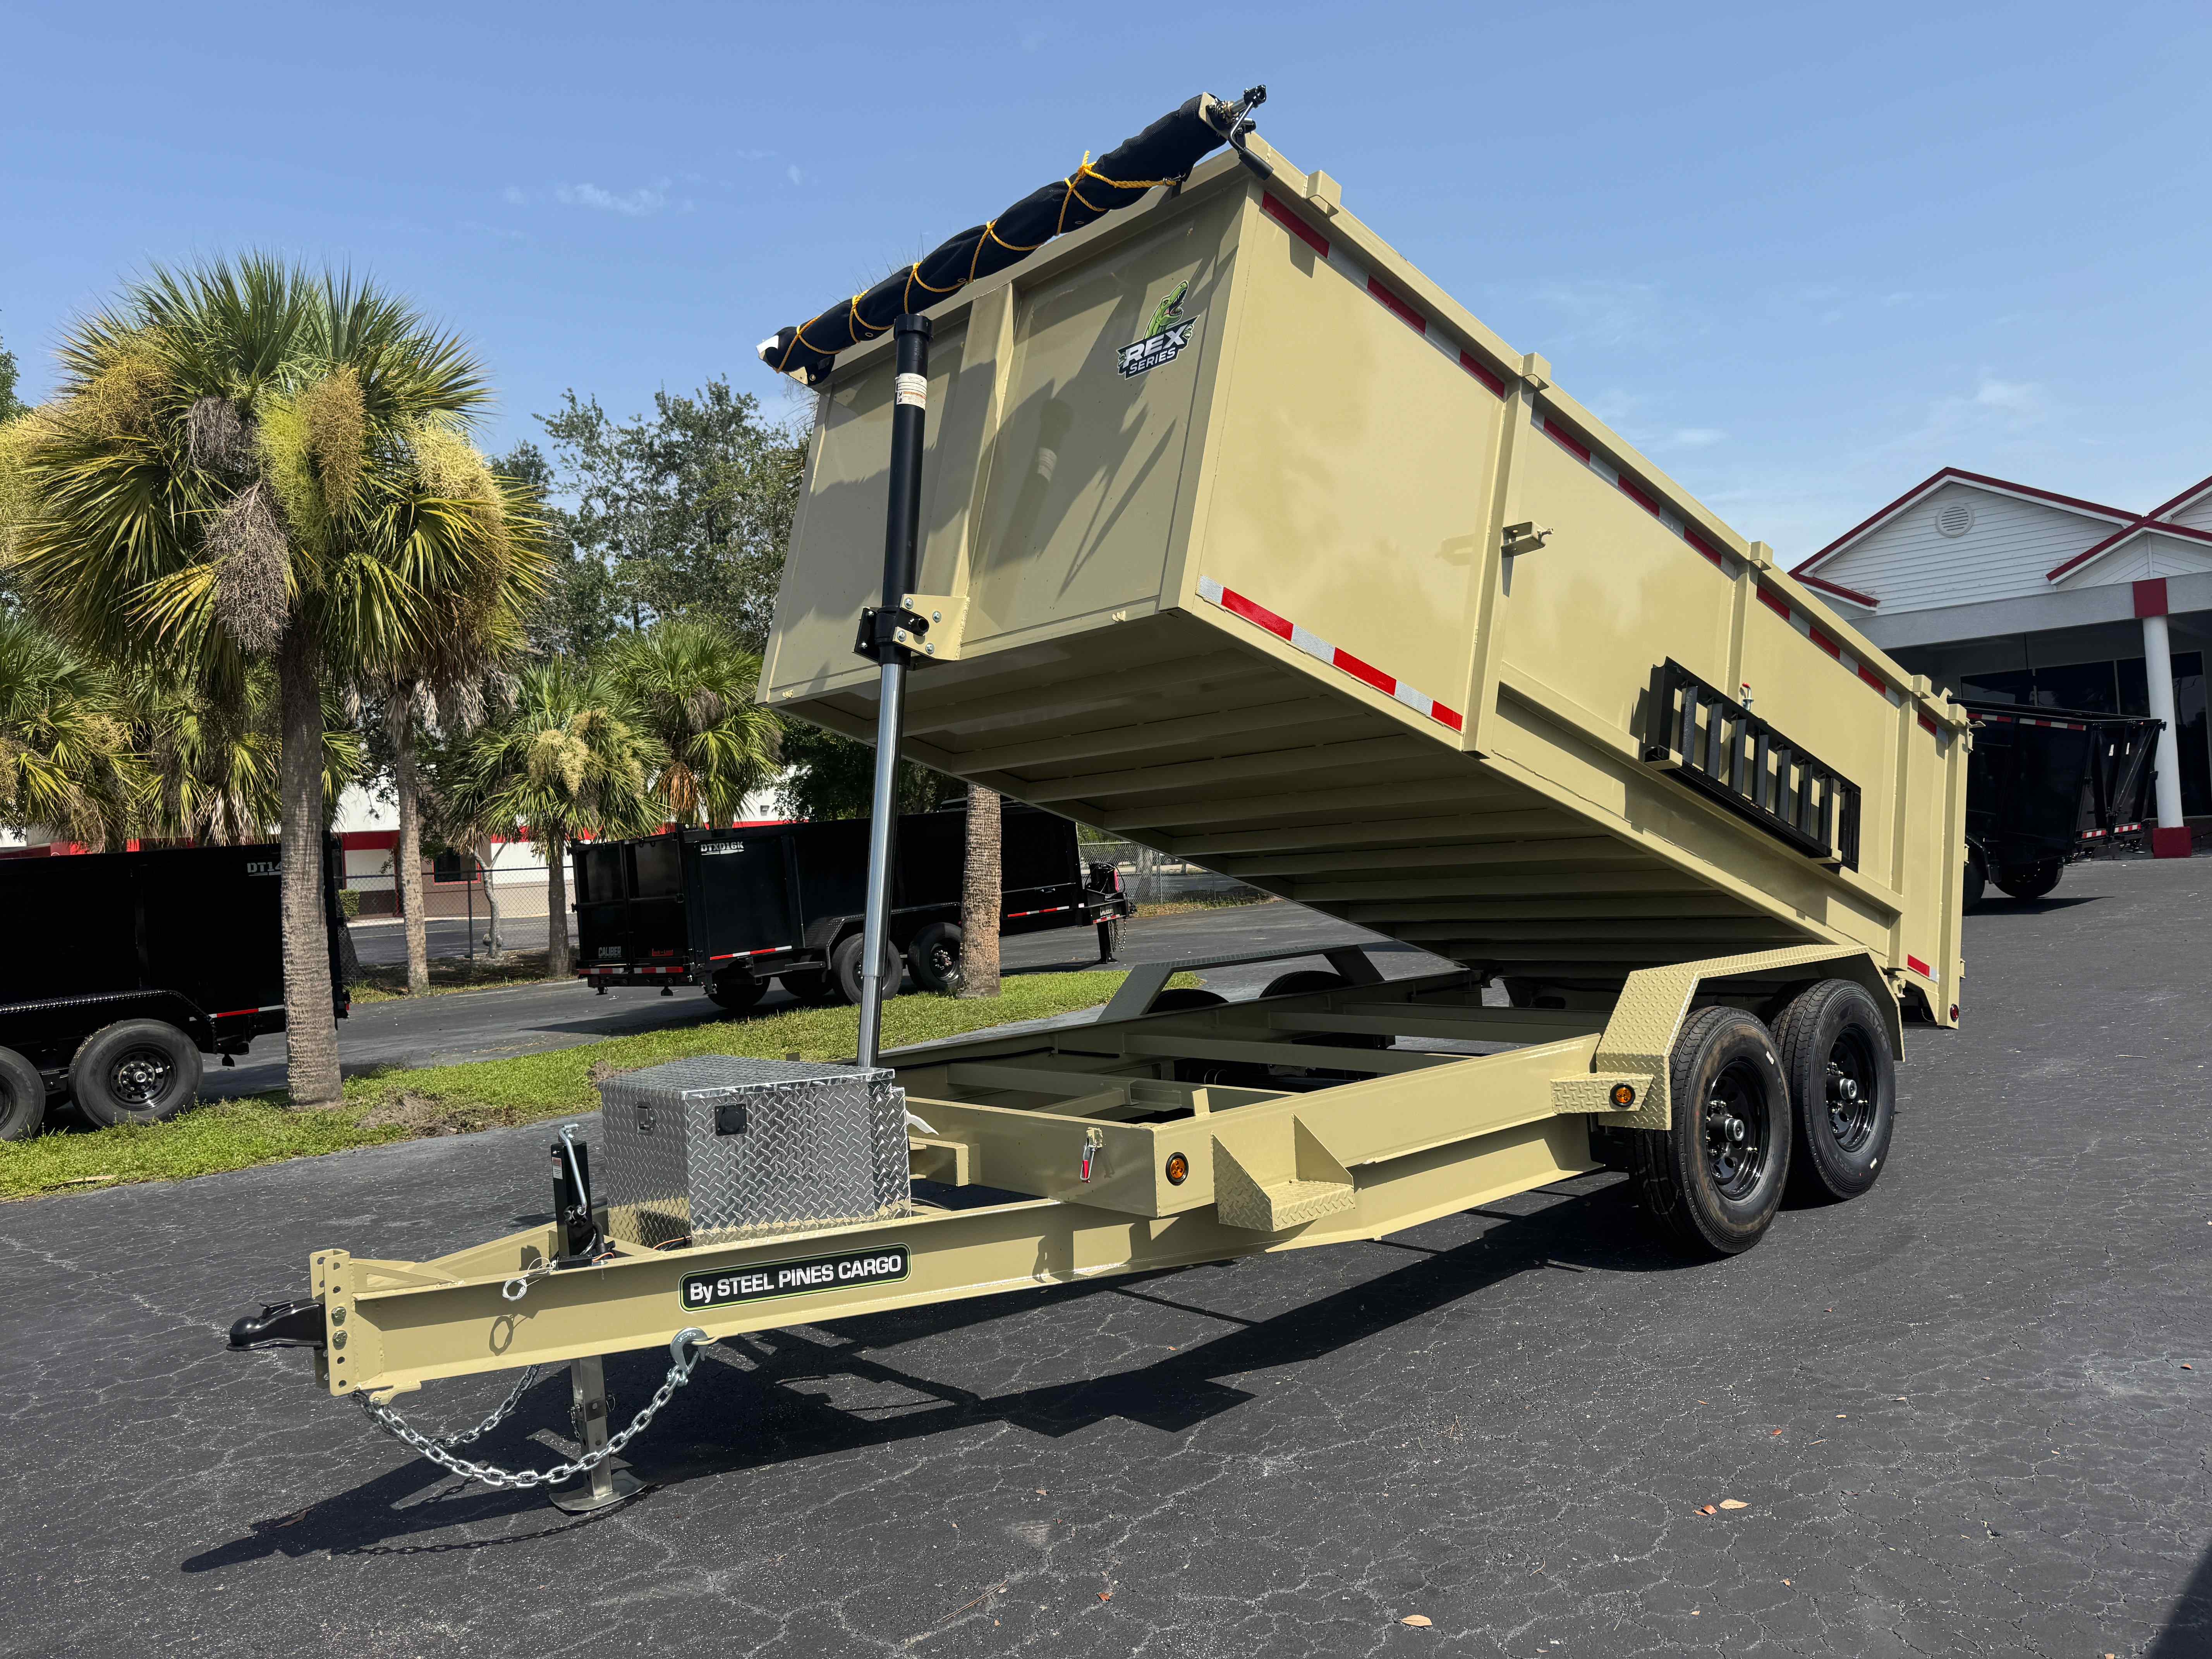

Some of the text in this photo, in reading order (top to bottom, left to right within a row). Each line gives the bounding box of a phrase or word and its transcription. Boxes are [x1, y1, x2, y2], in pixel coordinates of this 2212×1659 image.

[1123, 326, 1185, 369] REX
[1129, 347, 1175, 374] SERIES
[701, 842, 744, 852] DTXD16K
[598, 946, 621, 957] CALIBER
[690, 1255, 902, 1303] By STEEL PINES CARGO
